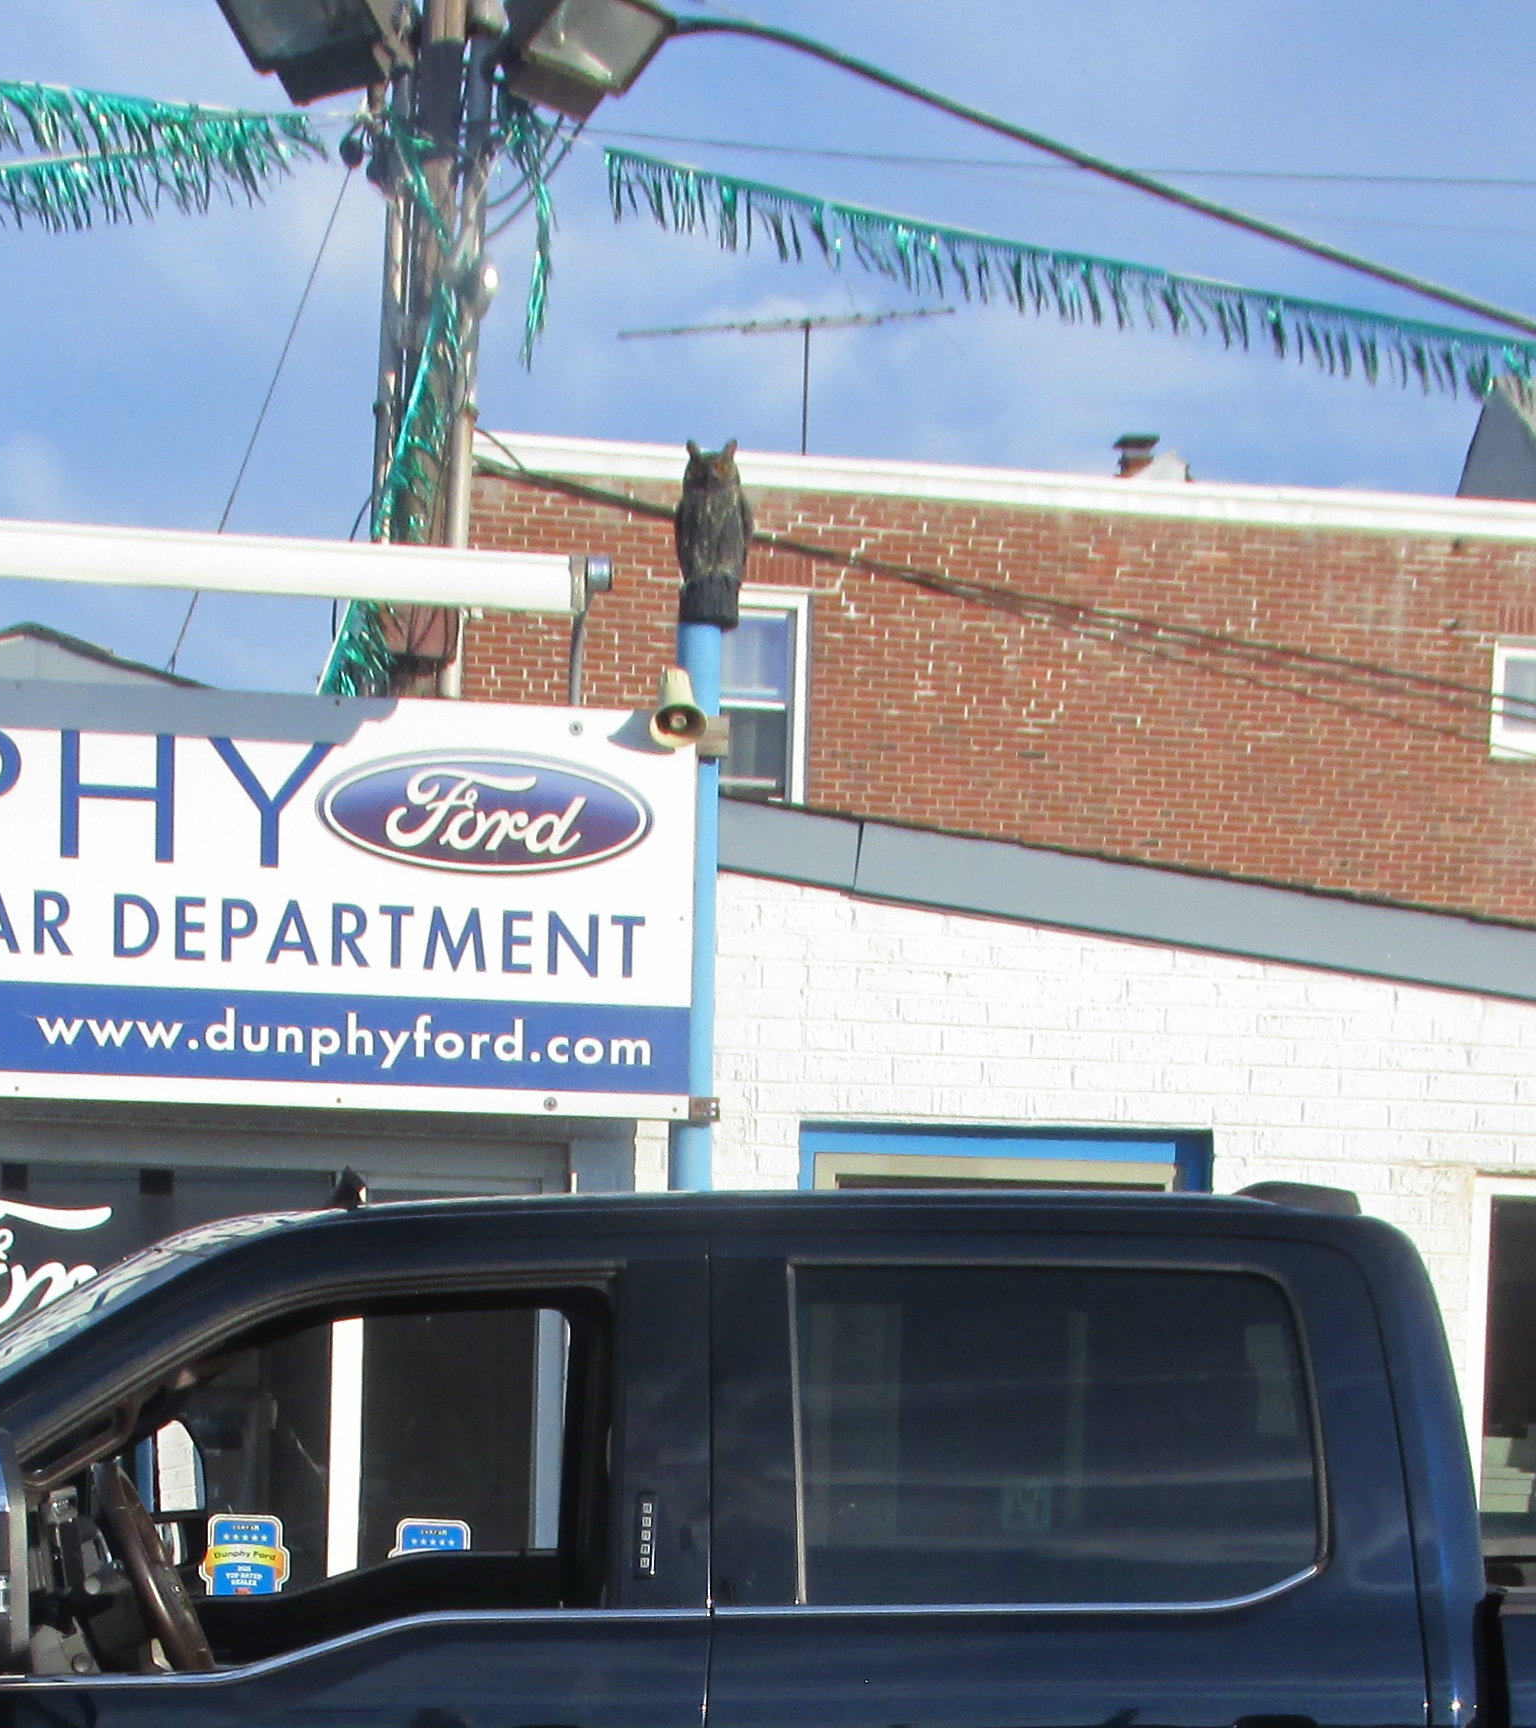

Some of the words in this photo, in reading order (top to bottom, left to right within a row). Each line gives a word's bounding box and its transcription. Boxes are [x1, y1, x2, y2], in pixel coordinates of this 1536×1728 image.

[385, 768, 587, 855] Ford
[113, 893, 646, 979] DEPARTMENT
[36, 1007, 653, 1069] www.dunphyford.com
[213, 1550, 251, 1560] Dunphy
[253, 1551, 276, 1561] Ford
